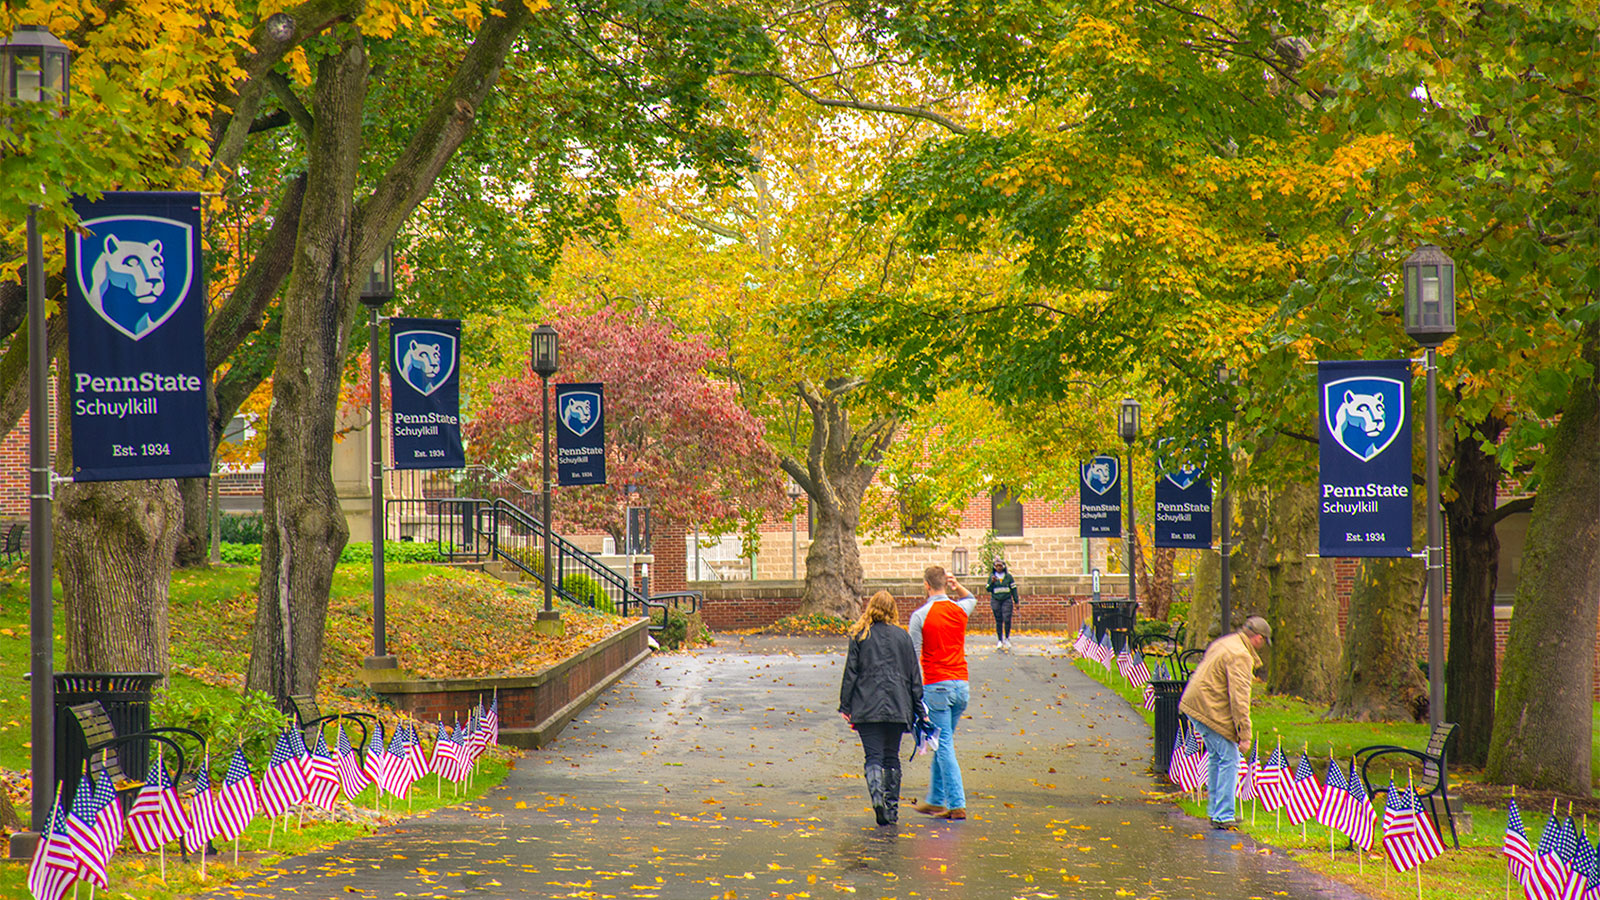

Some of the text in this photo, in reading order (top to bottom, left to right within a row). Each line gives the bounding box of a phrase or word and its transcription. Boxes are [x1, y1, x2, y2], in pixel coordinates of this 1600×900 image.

[75, 372, 201, 392] PennState
[75, 398, 158, 419] Schuylkill
[394, 412, 457, 424] PennState
[395, 425, 438, 437] Schuylkill
[112, 443, 170, 456] Est. 1934
[429, 449, 445, 457] 1934
[559, 446, 603, 456] PennState
[559, 456, 588, 464] Schuylkill
[1322, 484, 1409, 498] PennState
[1155, 502, 1210, 512] PennState
[1322, 501, 1379, 515] Schuylkill
[1156, 513, 1192, 523] Schuylkill
[1345, 532, 1386, 542] Est. 1934
